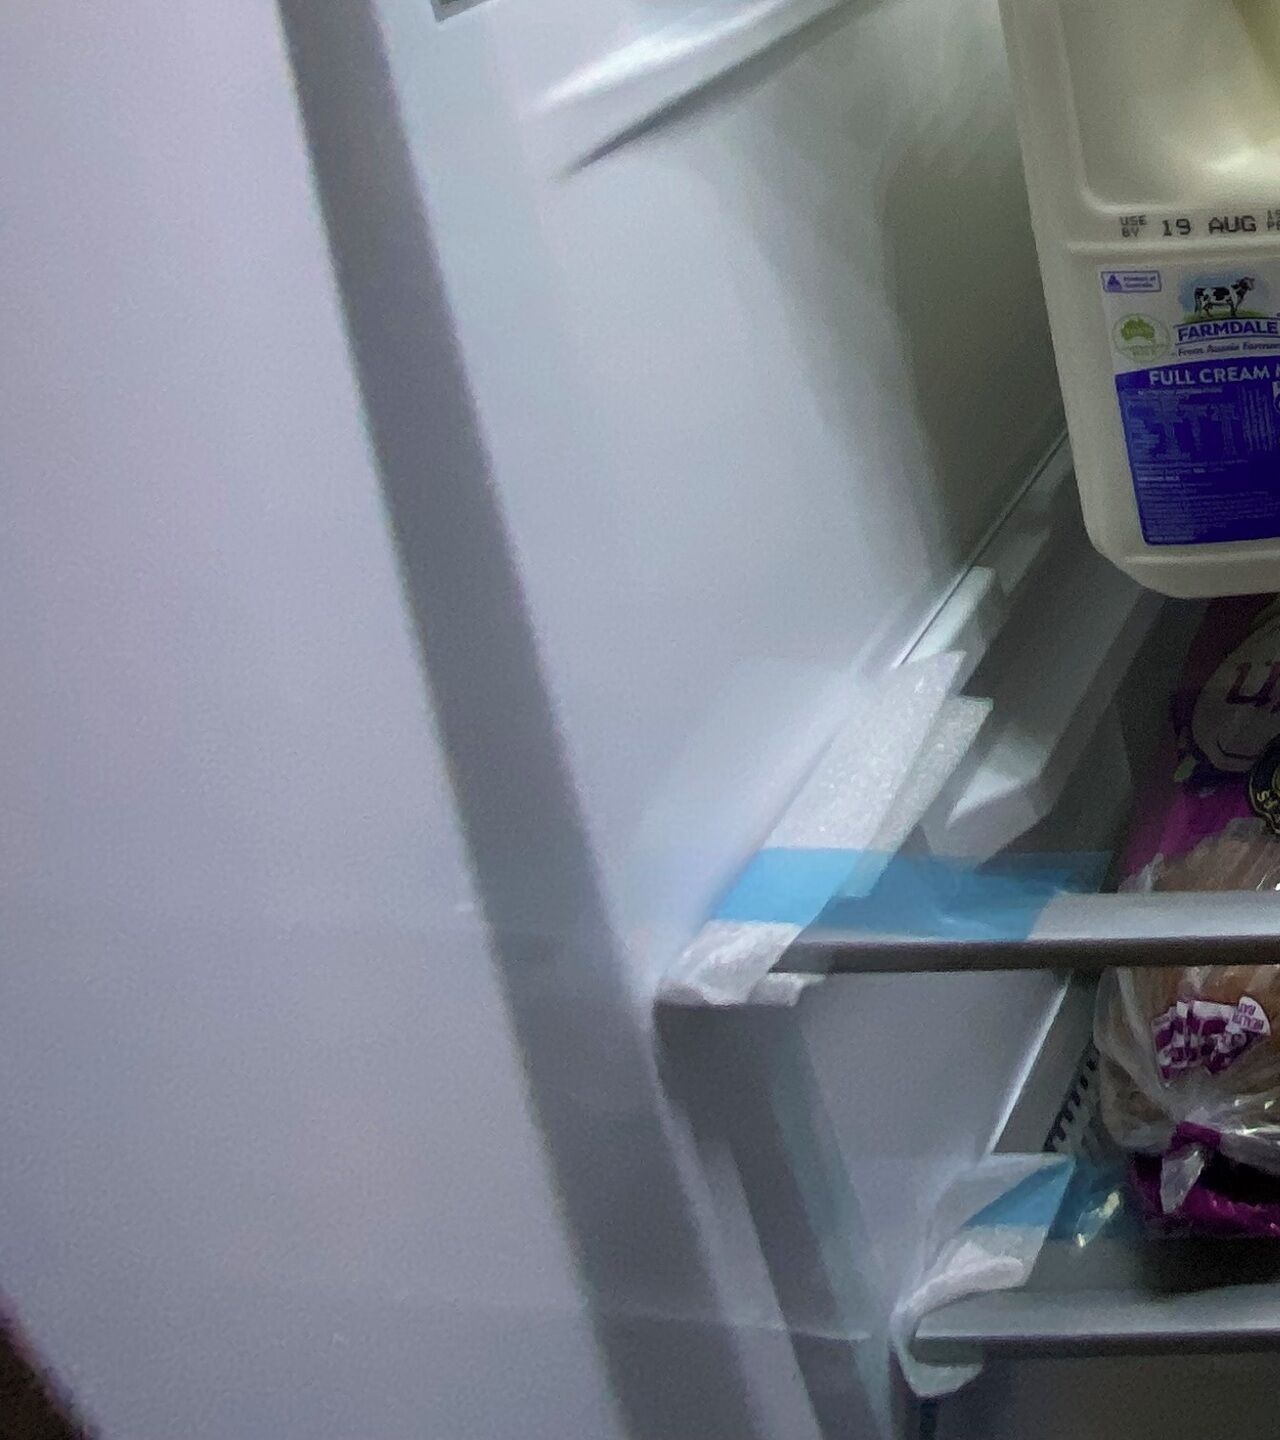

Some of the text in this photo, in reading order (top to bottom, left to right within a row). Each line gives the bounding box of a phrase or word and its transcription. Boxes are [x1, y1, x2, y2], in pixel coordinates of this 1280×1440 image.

[1163, 216, 1257, 236] 19 AUG
[1177, 321, 1279, 342] FARMDALE
[1149, 369, 1196, 385] FULL
[1199, 364, 1271, 383] CREAM
